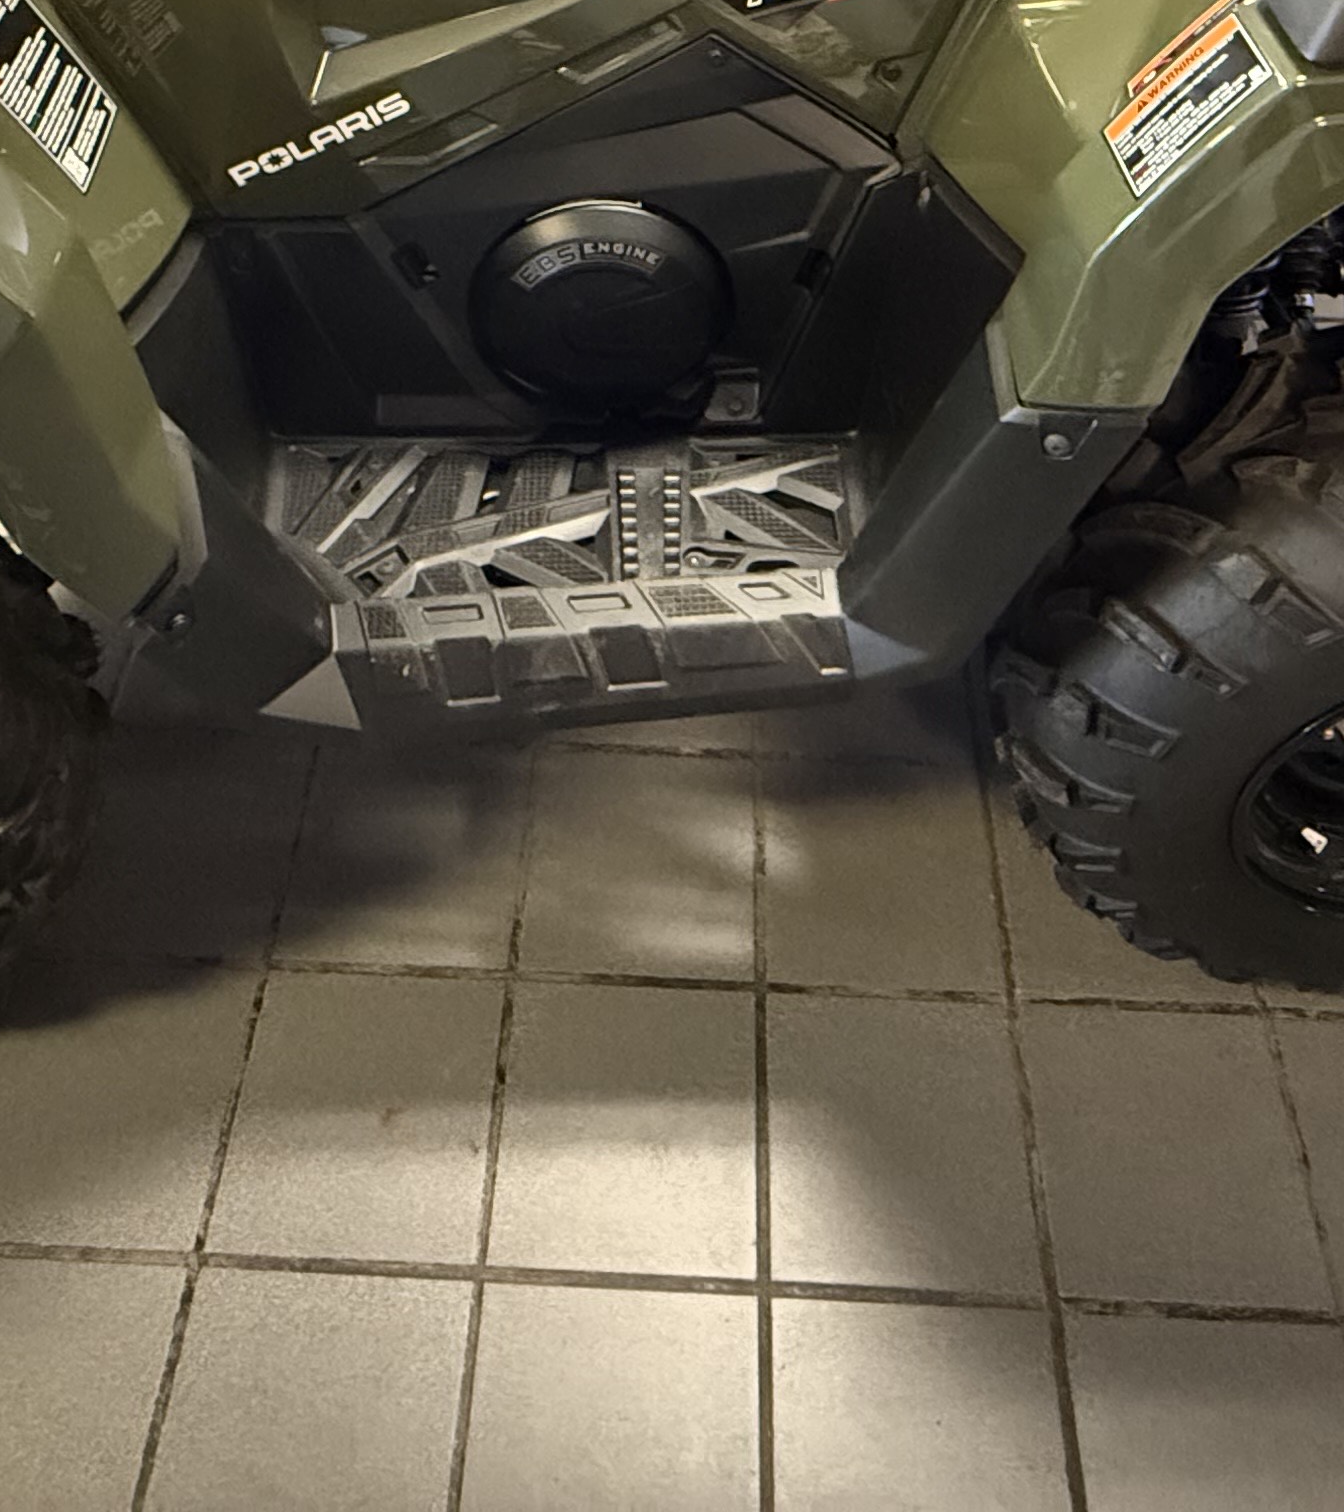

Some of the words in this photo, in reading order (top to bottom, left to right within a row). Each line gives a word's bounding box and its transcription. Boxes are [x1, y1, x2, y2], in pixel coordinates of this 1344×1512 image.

[1147, 46, 1205, 100] WARNING
[227, 91, 411, 188] POLARIS
[519, 245, 578, 286] EBS
[583, 242, 661, 266] ENGINE
